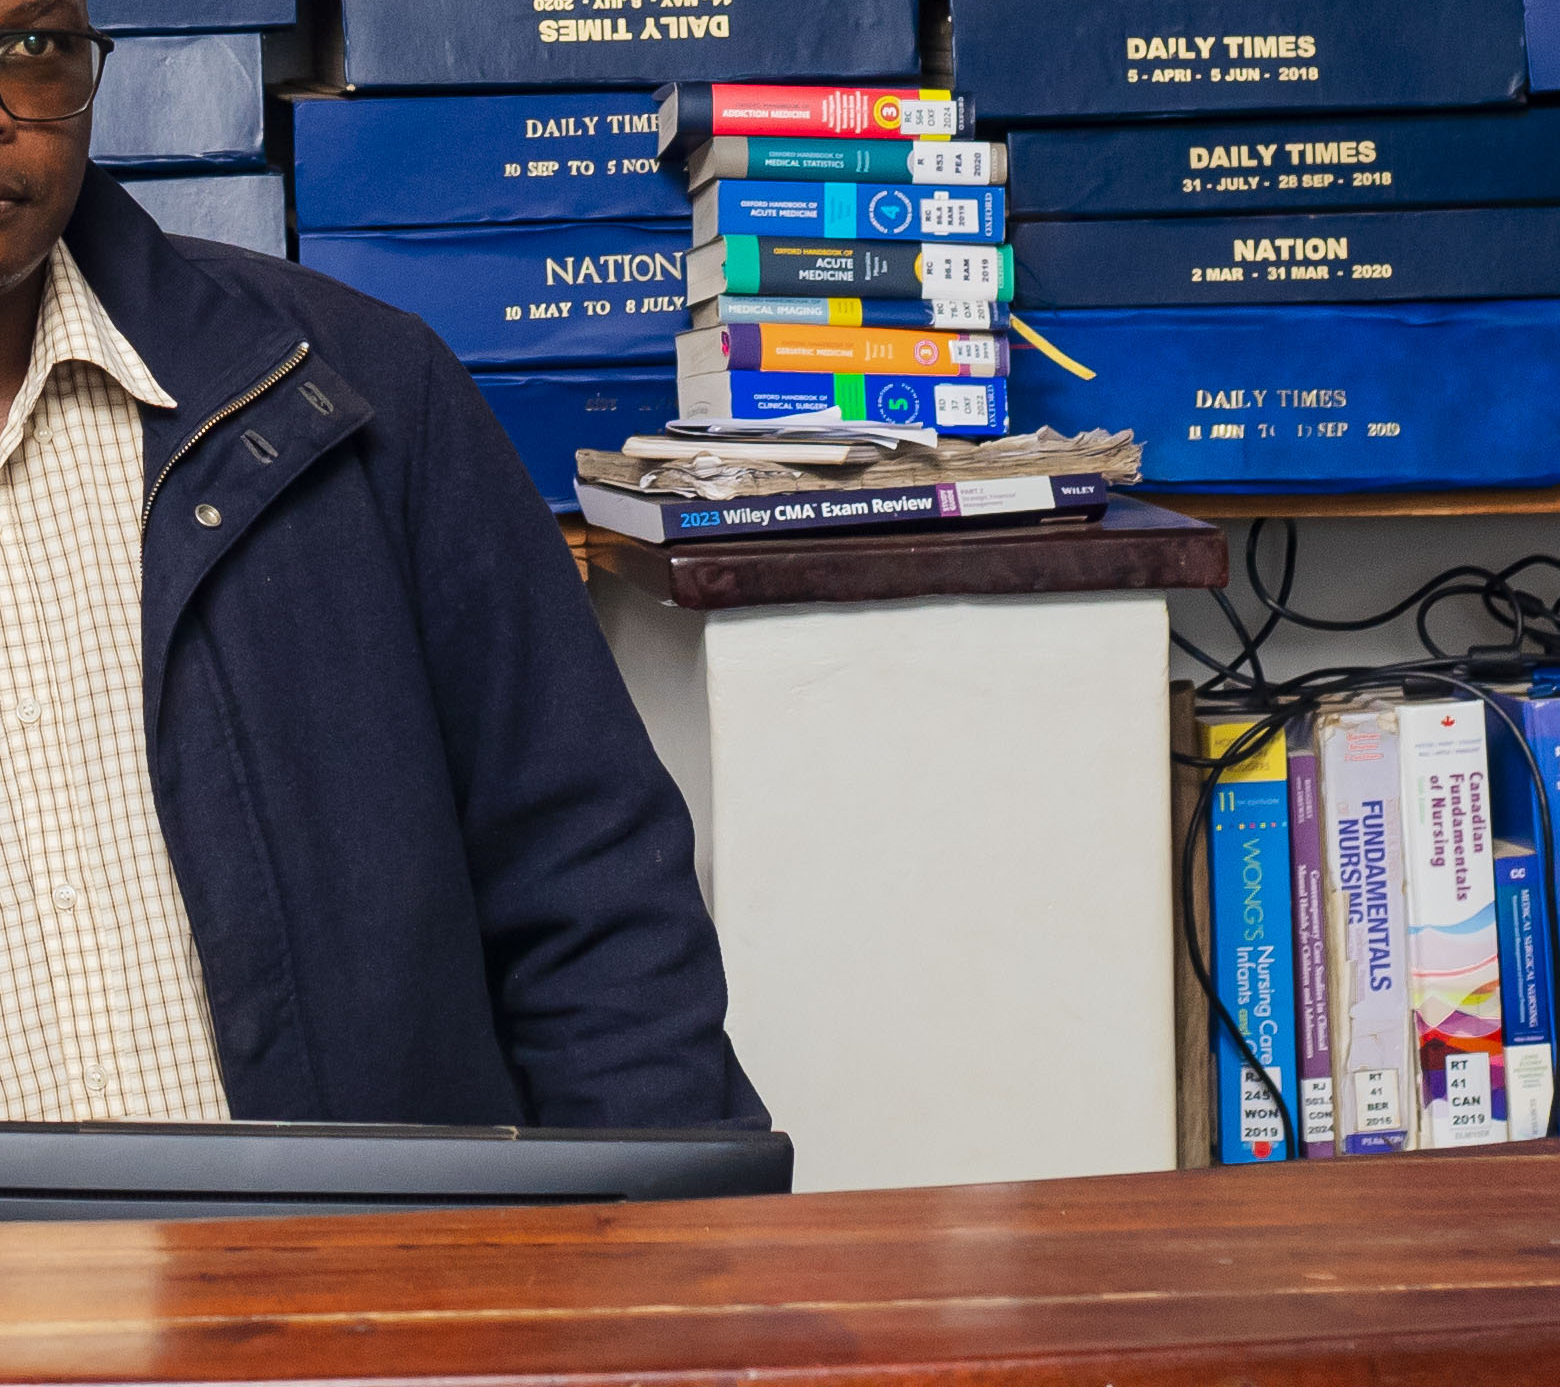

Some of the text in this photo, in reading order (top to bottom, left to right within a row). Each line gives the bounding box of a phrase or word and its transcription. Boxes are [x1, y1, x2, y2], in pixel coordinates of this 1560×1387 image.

[539, 15, 729, 42] DAILY TIMES
[1190, 141, 1376, 169] DAILY TIMES
[1234, 238, 1347, 261] NATION
[547, 252, 683, 285] NATION
[816, 258, 853, 269] ACUTE
[799, 270, 853, 281] MEDICINE
[1061, 486, 1094, 494] WILEY
[681, 511, 720, 527] 2023
[723, 508, 770, 526] Wiley
[821, 502, 868, 517] Exam
[872, 496, 932, 513] Review
[1430, 775, 1446, 868] of Nursing
[1469, 771, 1484, 853] Canadian
[1449, 773, 1467, 901] Fundamentals
[1450, 1059, 1468, 1071] RT
[1451, 1079, 1466, 1089] 41
[1452, 1096, 1480, 1107] CAN
[1453, 1113, 1485, 1125] 2019
